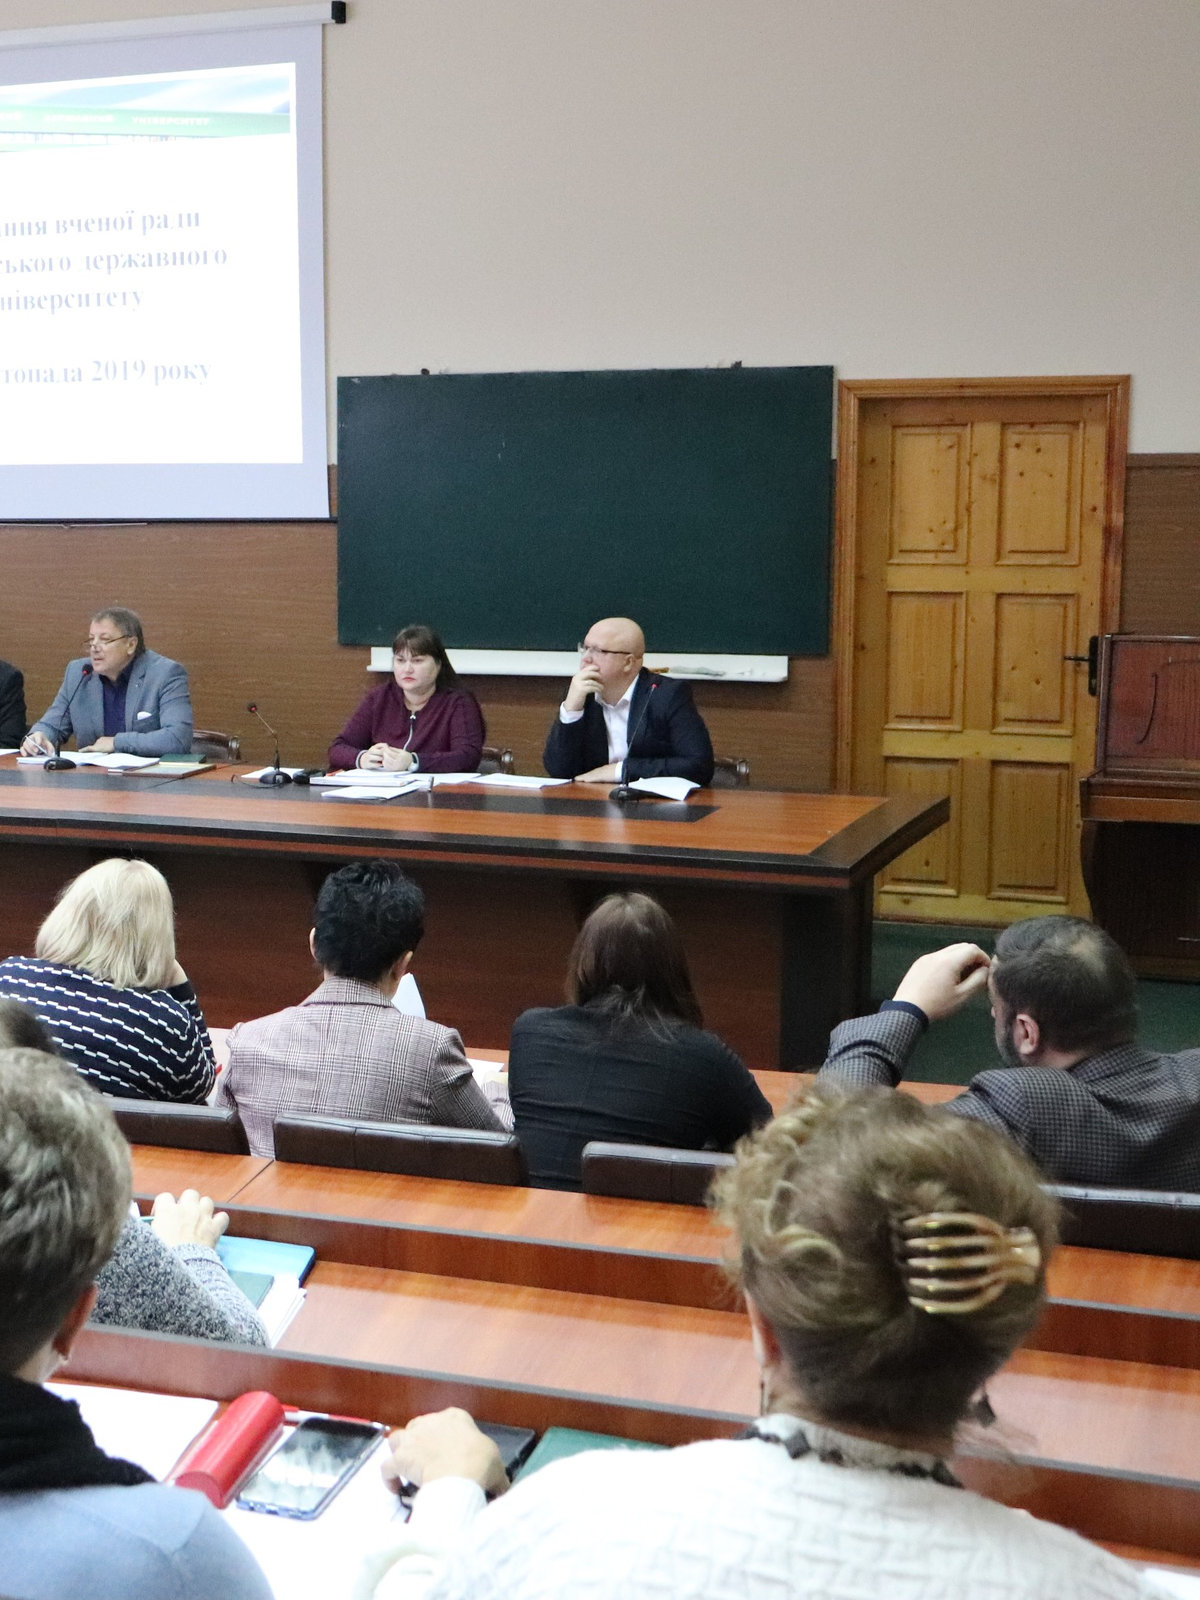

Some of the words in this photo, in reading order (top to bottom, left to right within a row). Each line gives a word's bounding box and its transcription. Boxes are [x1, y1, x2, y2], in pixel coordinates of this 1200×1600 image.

[55, 208, 136, 234] вченої
[91, 358, 147, 382] 2019
[153, 362, 211, 387] року
